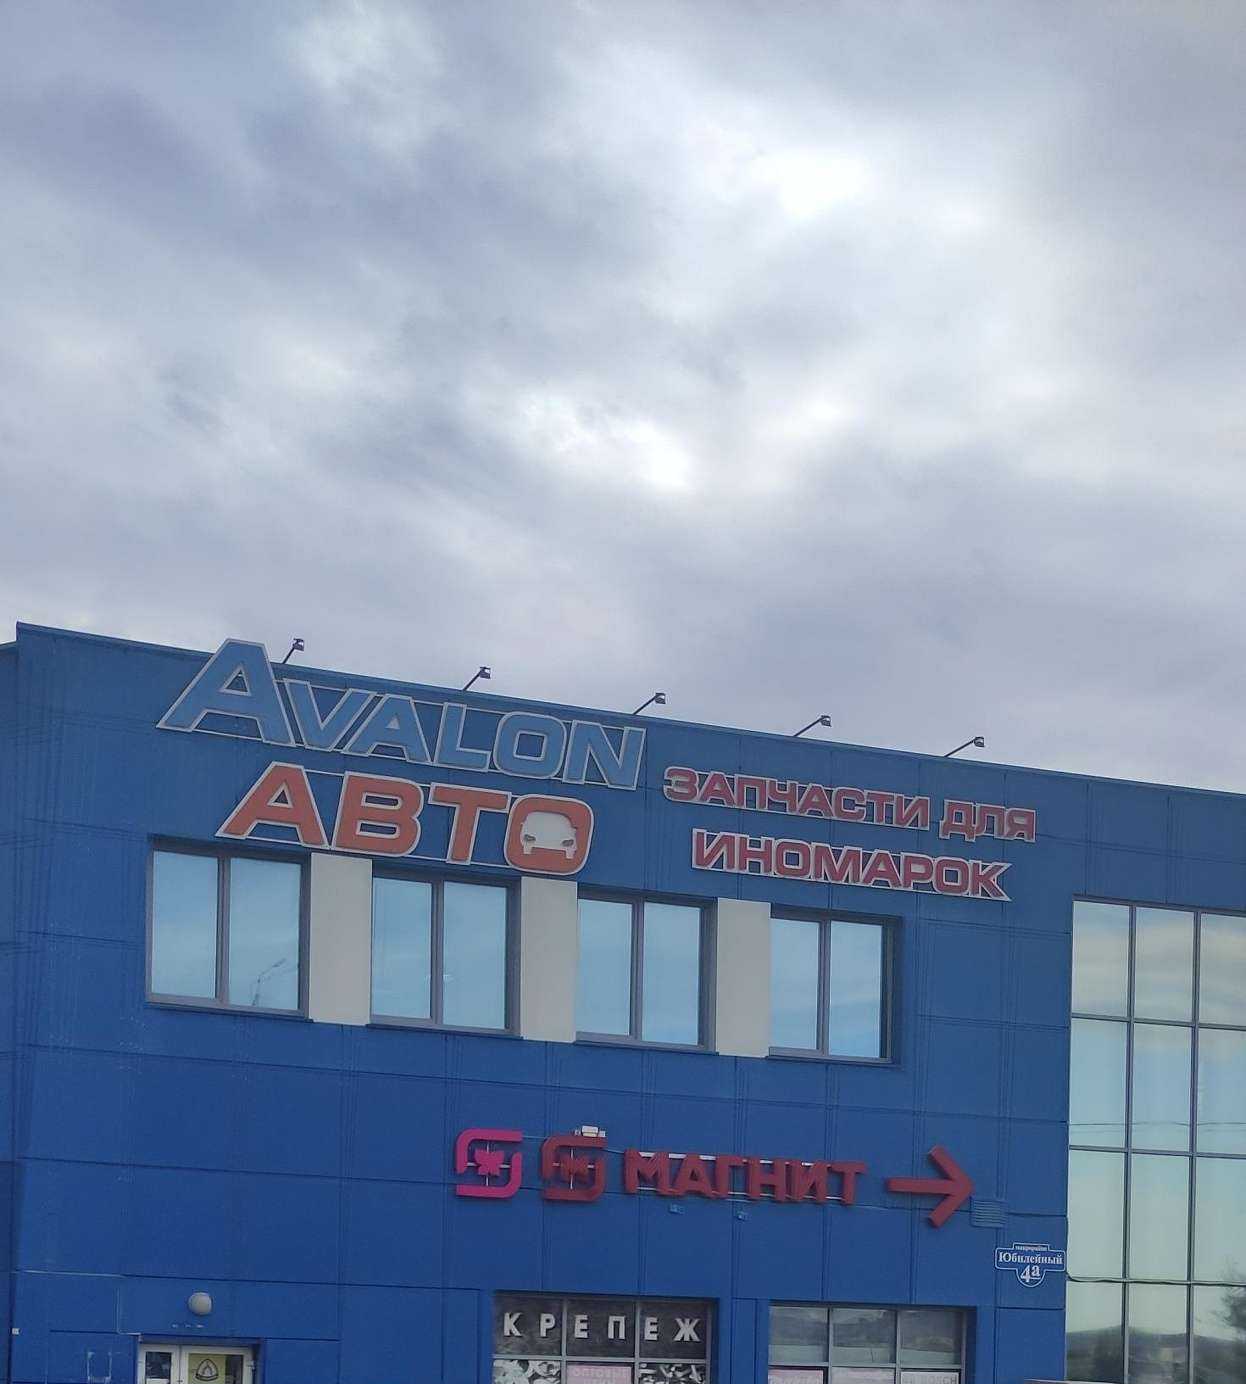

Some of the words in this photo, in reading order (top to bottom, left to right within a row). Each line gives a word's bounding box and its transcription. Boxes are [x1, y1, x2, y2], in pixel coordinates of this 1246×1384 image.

[156, 638, 647, 791] AVALON
[214, 761, 595, 876] АВТО
[663, 766, 931, 831] ЗАПЧАСТИ
[938, 799, 1037, 843] ДЛЯ
[691, 828, 1013, 903] ИНОМАРОК
[623, 1148, 867, 1206] МАГНИТ
[998, 1250, 1064, 1265] Юбилейный
[503, 1312, 700, 1343] КРЕПЕЖ
